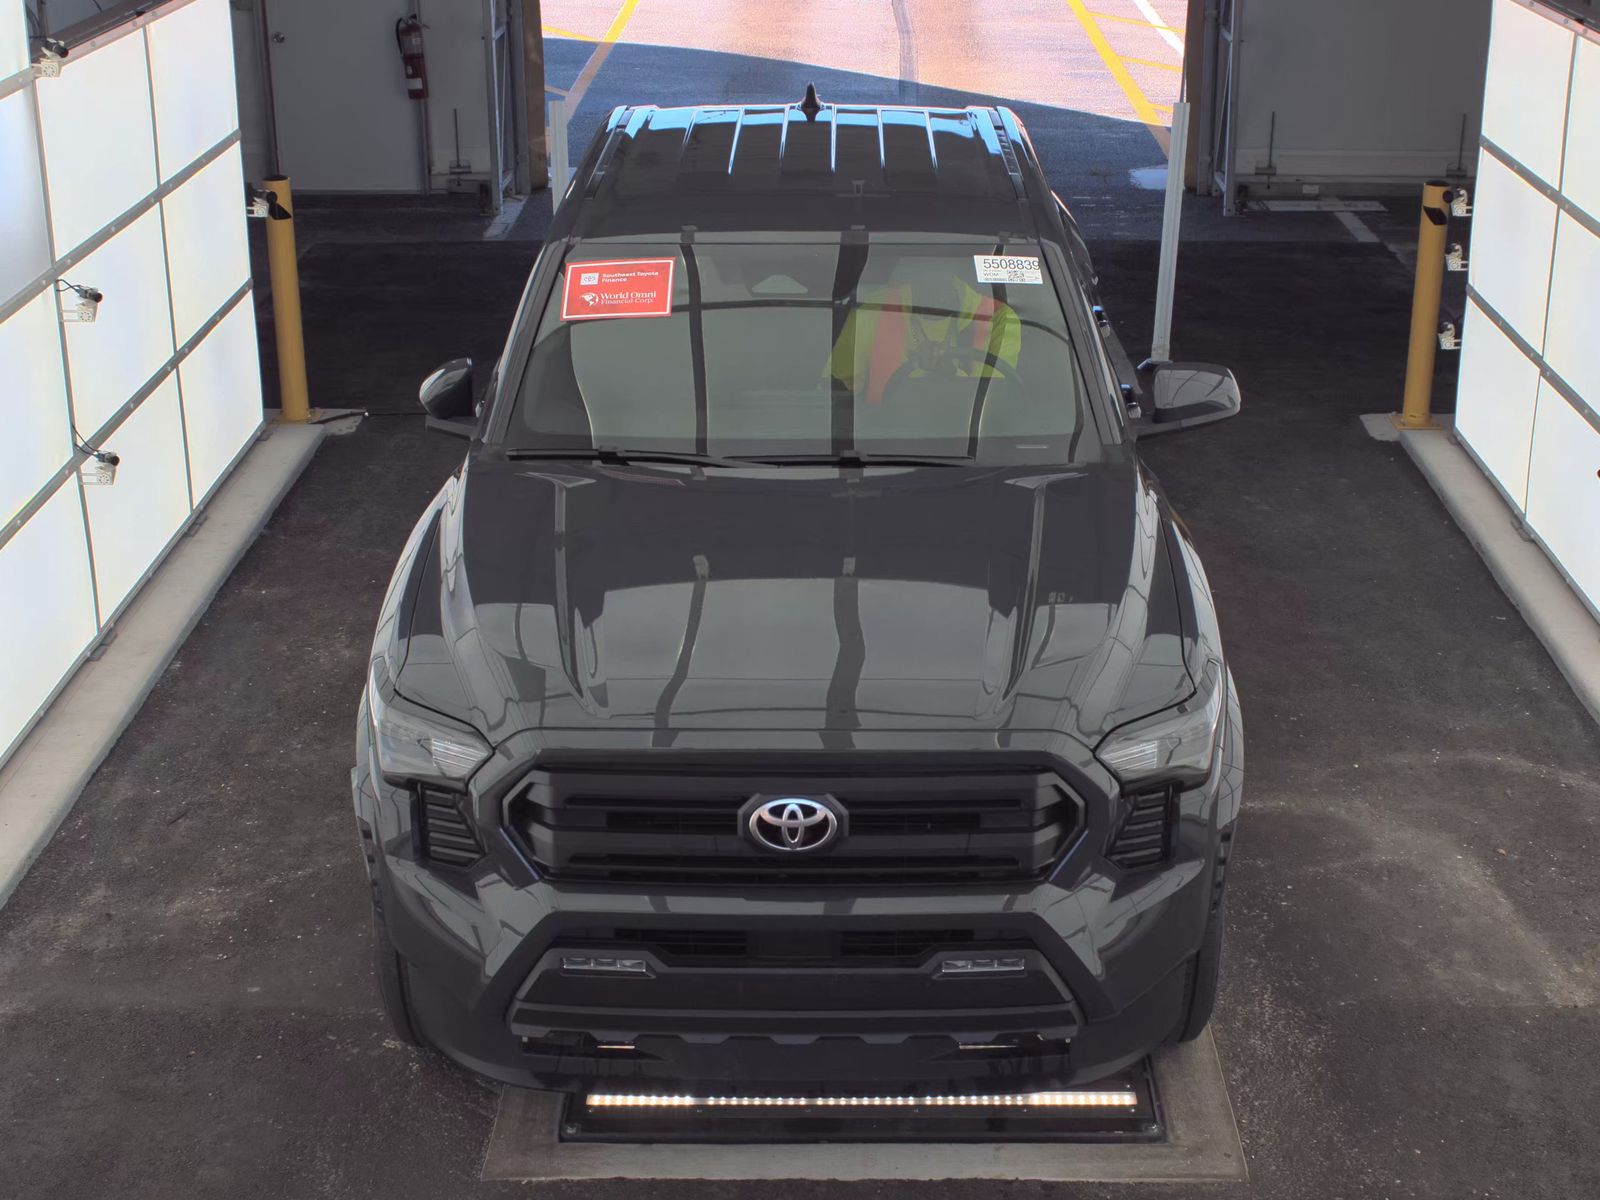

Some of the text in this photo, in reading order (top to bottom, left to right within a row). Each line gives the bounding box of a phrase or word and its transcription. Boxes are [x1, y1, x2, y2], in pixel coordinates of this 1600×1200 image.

[983, 258, 1040, 270] 5508839
[600, 290, 656, 299] World Omni
